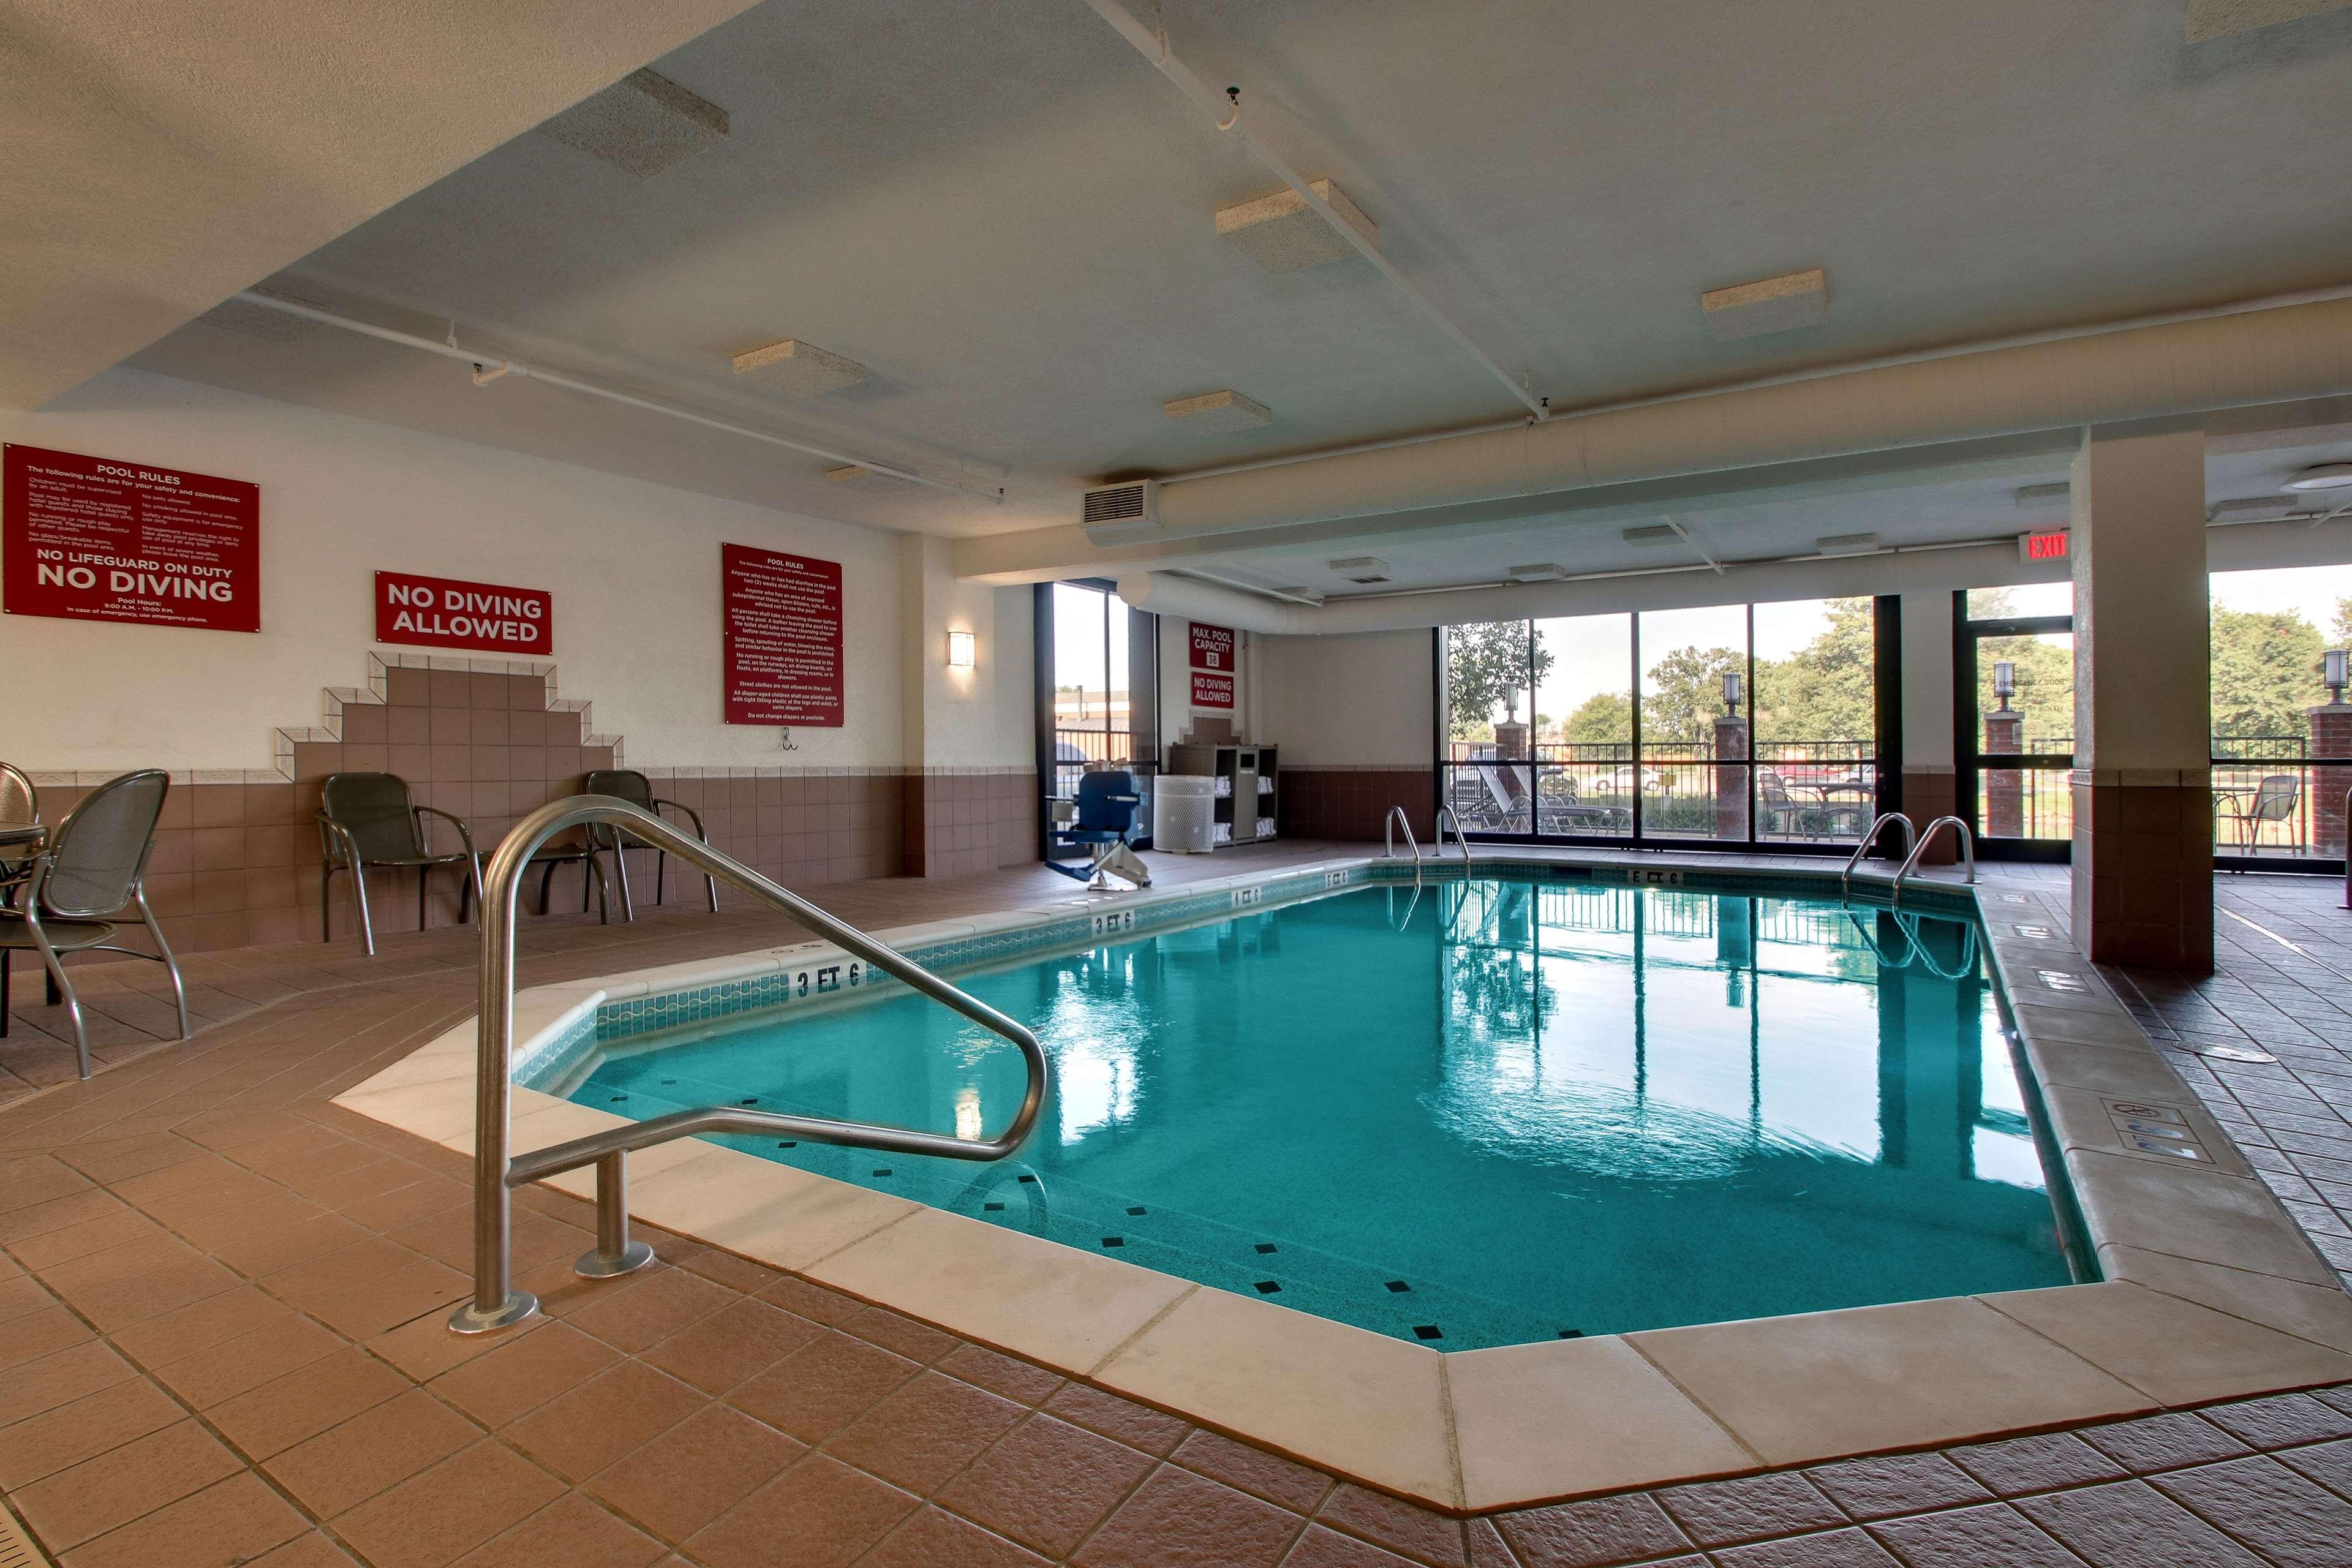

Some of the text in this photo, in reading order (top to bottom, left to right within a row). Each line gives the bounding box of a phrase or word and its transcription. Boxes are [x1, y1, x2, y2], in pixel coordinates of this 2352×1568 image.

[97, 464, 180, 485] POOL RULES
[29, 477, 57, 486] Children
[87, 486, 121, 496] supervised
[45, 468, 83, 480] following
[154, 484, 177, 494] safety
[194, 490, 240, 502] convenience:
[45, 504, 78, 514] registered
[99, 501, 131, 511] registered
[153, 504, 178, 513] smoking
[40, 513, 67, 522] running
[2029, 533, 2068, 559] EXIT
[37, 548, 232, 578] NO LIFEGUARD ON DUTY
[731, 569, 750, 578] Anyone
[37, 563, 232, 602] NO DIVING
[388, 584, 541, 619] NO DIVING
[393, 611, 538, 642] ALLOWED
[1193, 627, 1232, 643] MAX. POOL
[1195, 639, 1230, 653] CAPACITY
[1208, 654, 1216, 665] 38
[1194, 677, 1232, 690] NO DIVING
[1196, 690, 1231, 703] ALLOWED
[818, 966, 840, 989] FT
